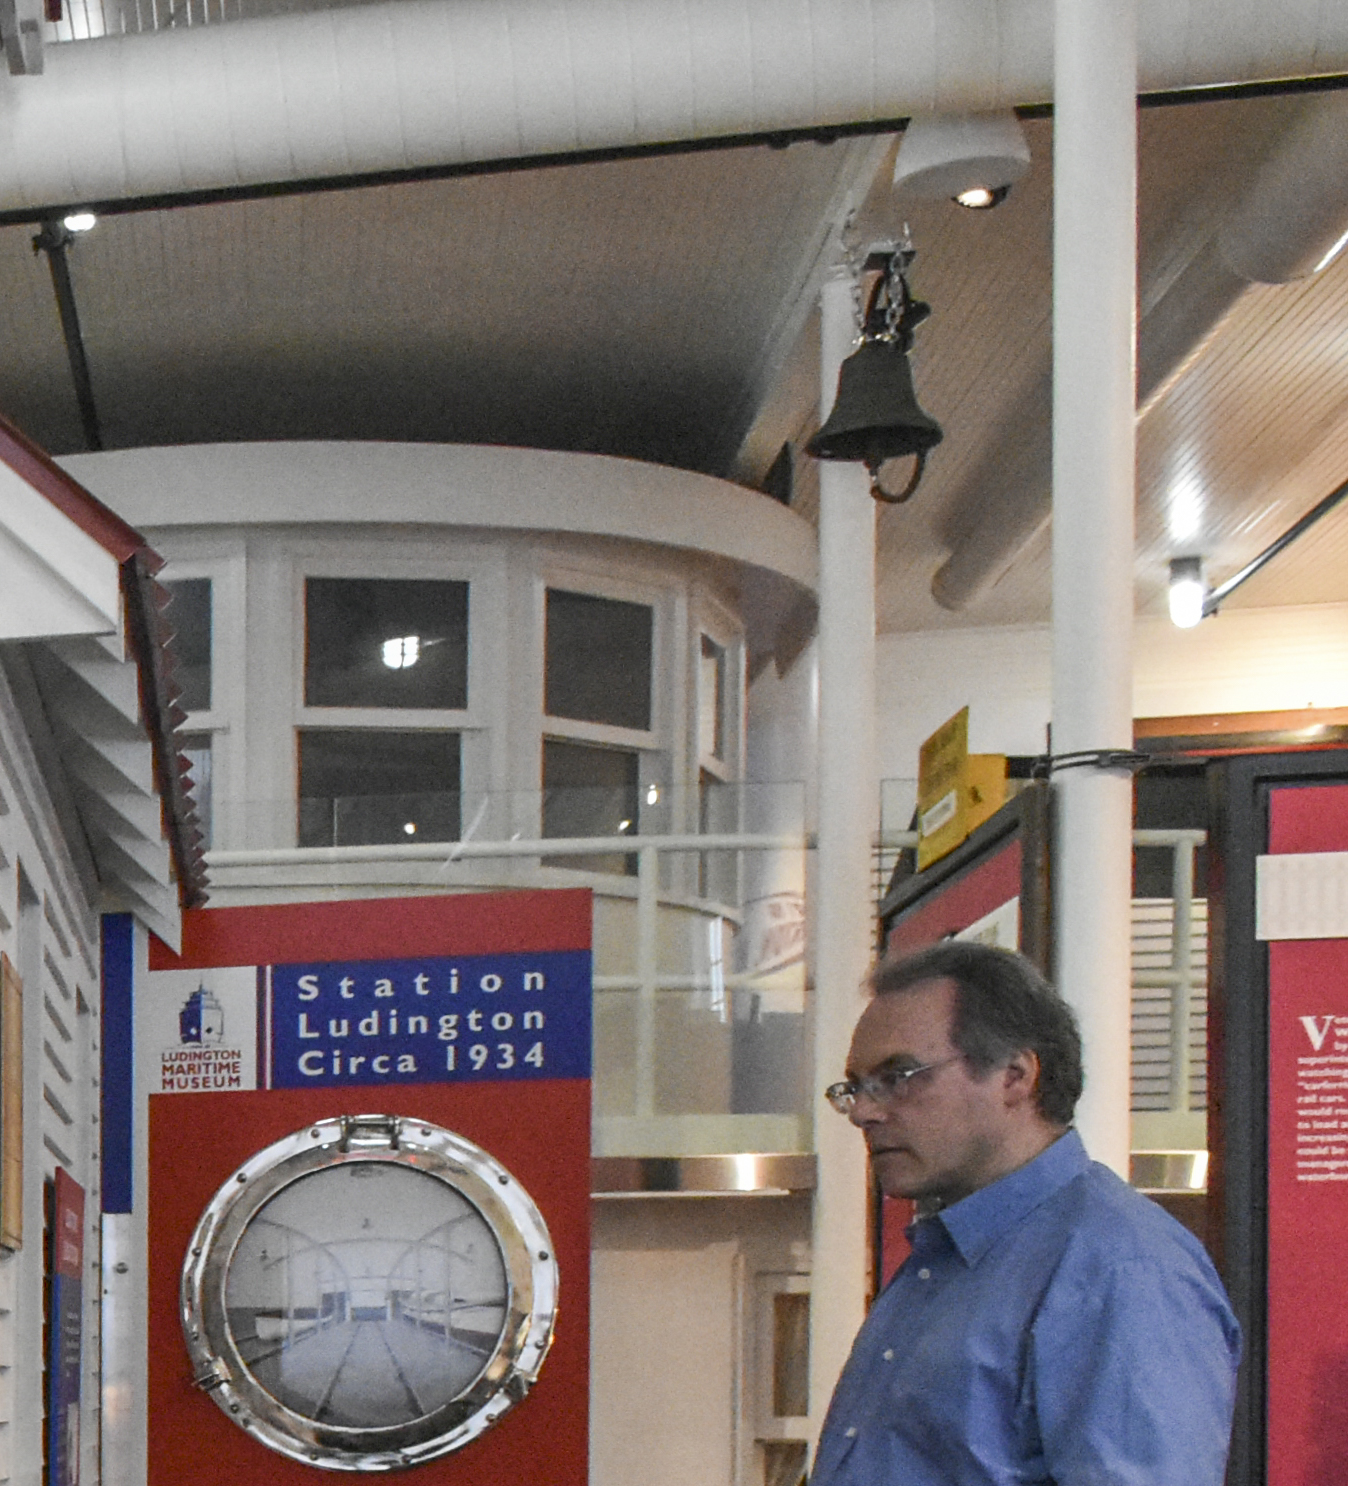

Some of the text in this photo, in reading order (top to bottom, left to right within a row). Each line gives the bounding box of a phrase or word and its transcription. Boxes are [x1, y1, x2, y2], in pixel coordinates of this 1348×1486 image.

[296, 968, 546, 1003] Station
[297, 1007, 546, 1041] Ludington
[161, 1050, 242, 1063] LUDINGTON
[297, 1042, 546, 1077] Circa 1934
[161, 1062, 242, 1076] MARITIME
[161, 1075, 242, 1090] MUSEUM
